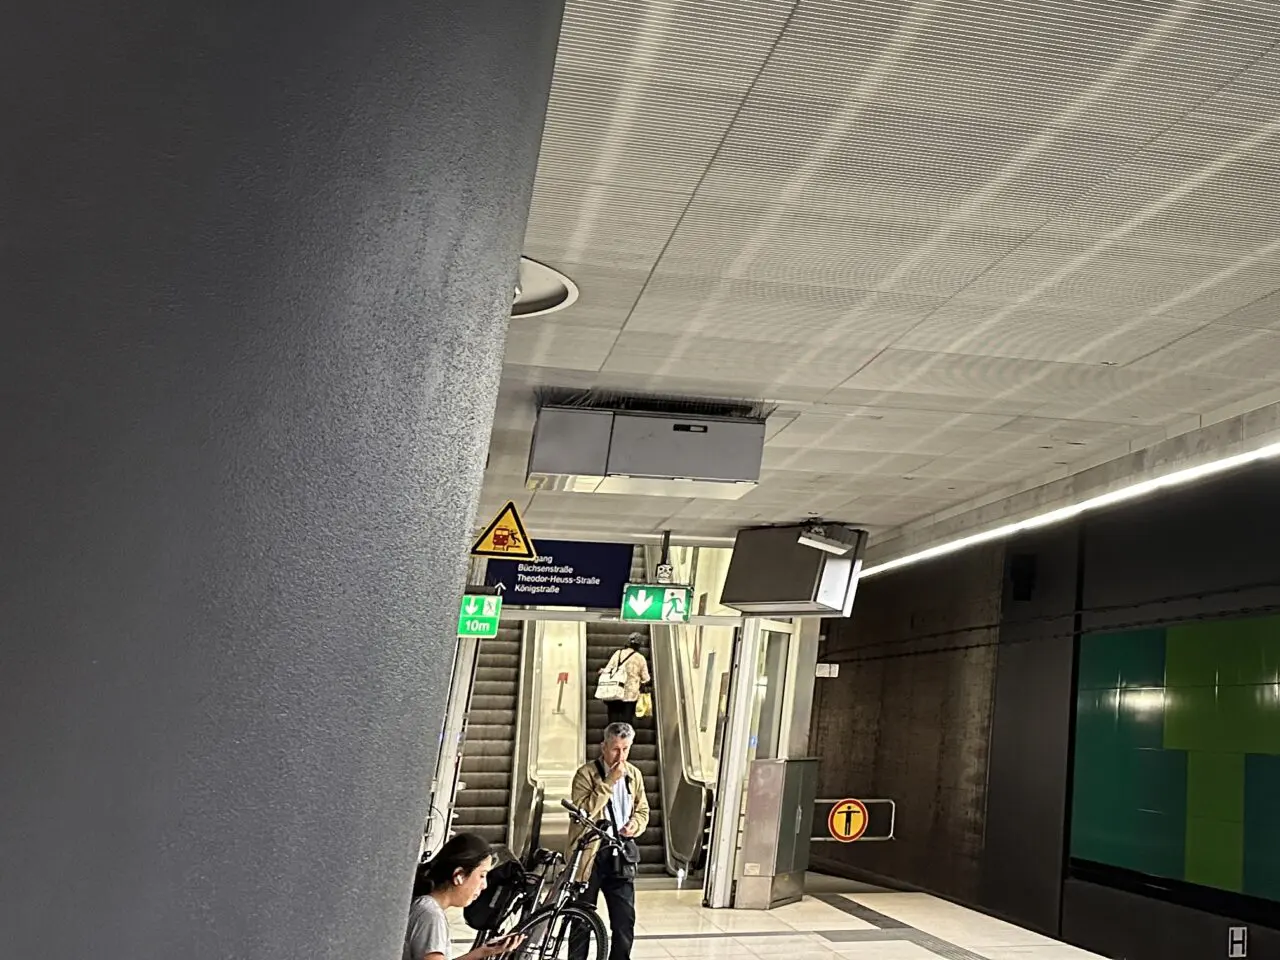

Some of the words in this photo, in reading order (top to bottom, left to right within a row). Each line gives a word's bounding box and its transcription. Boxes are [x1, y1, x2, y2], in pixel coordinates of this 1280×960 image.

[534, 555, 553, 564] gang
[517, 563, 574, 574] Büchsenstraße
[517, 573, 601, 585] Theodor-Heuss-Straße
[514, 584, 560, 594] Königstraße
[465, 619, 490, 632] 10m
[1230, 929, 1246, 956] H
